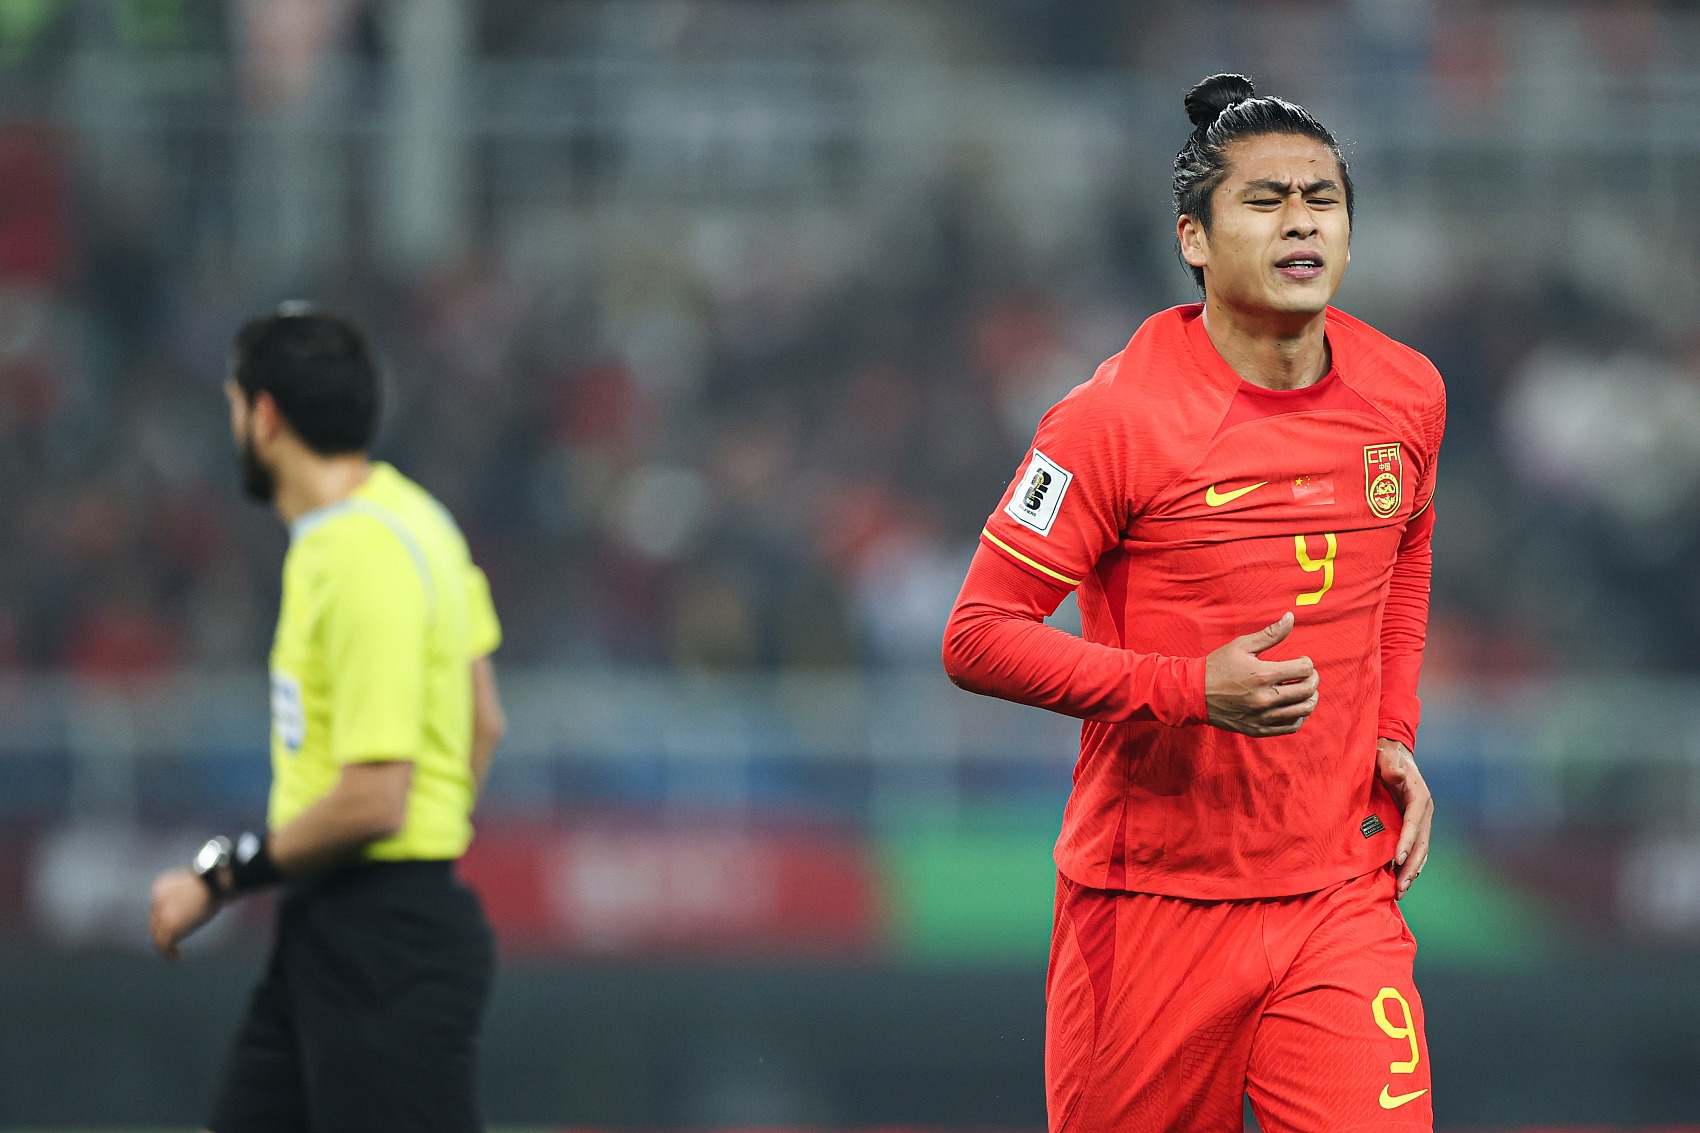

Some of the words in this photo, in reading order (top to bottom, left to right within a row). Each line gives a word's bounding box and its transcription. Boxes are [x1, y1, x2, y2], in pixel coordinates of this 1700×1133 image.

[1368, 448, 1397, 464] CFA
[1295, 533, 1337, 606] 9
[1372, 987, 1419, 1074] 9
